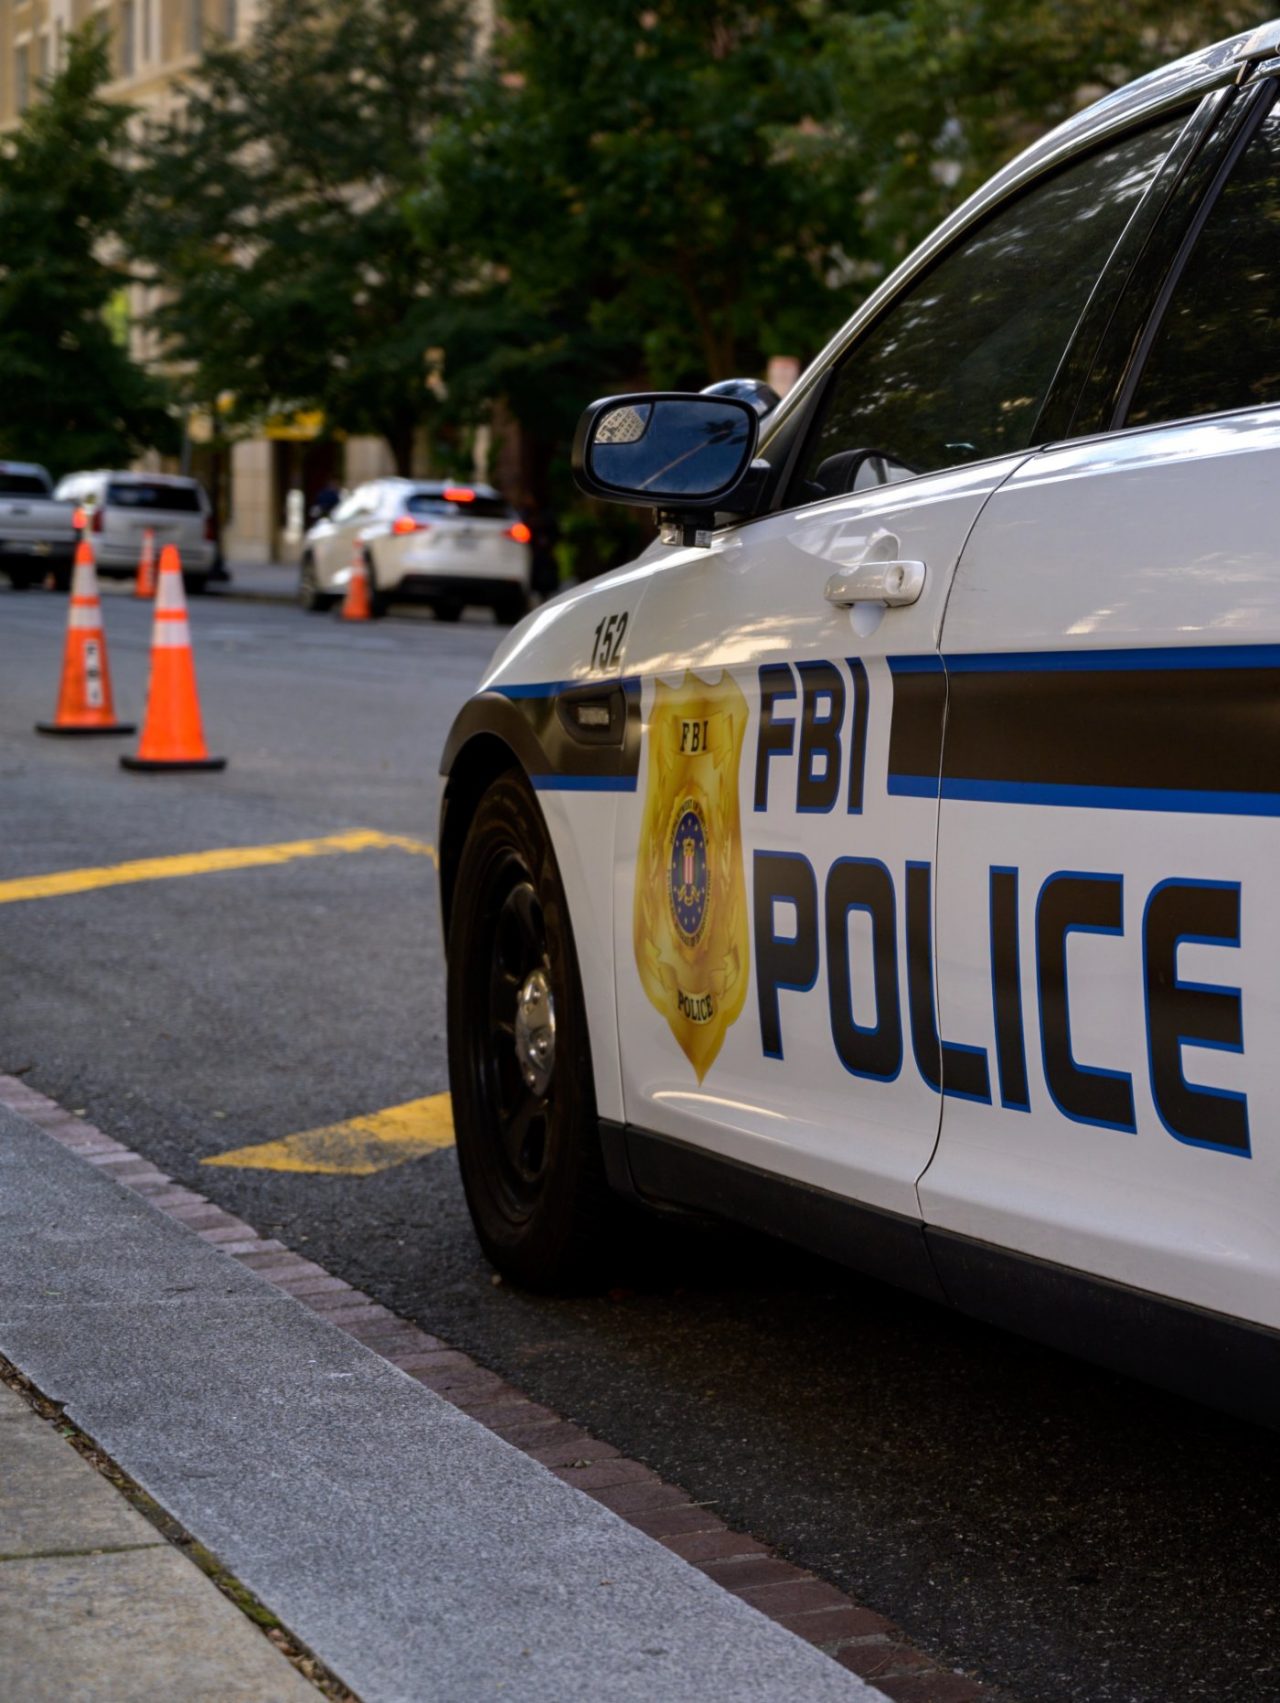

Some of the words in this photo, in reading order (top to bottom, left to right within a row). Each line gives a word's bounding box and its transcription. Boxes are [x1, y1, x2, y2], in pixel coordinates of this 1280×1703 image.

[590, 611, 629, 672] 152
[680, 720, 709, 752] FBI
[754, 656, 870, 815] FBI
[677, 989, 714, 1021] POLICE
[753, 848, 1253, 1159] POLICE
